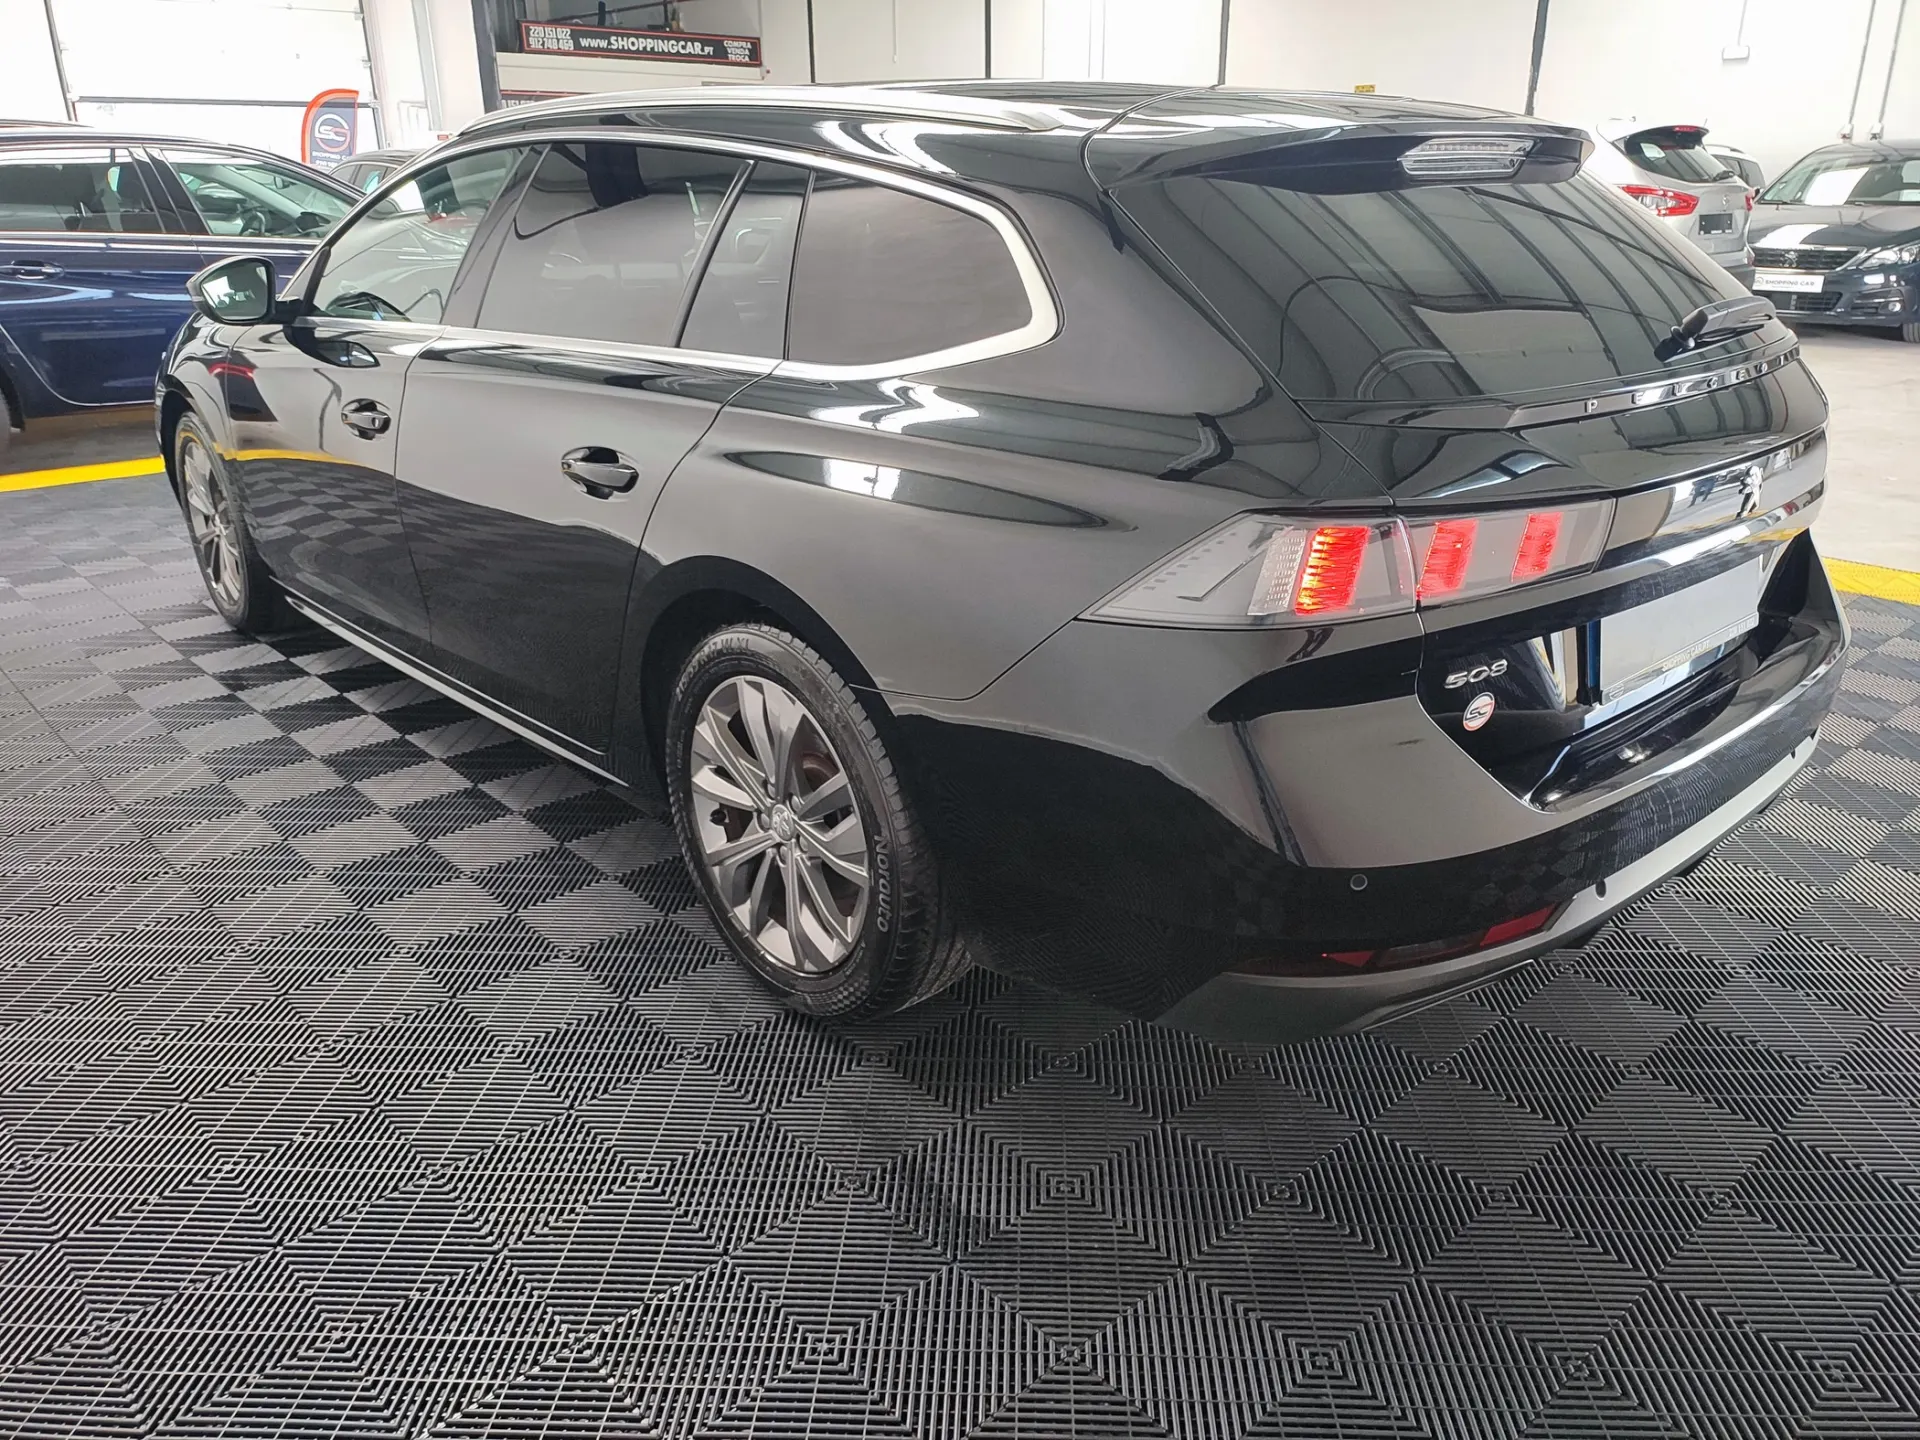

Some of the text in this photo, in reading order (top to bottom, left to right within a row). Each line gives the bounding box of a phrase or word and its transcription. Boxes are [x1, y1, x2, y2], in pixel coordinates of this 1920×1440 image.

[528, 26, 571, 39] 220 151 022
[528, 37, 543, 49] 912
[558, 39, 574, 50] 469
[579, 36, 714, 56] www.SHOPPINGCAR.PT
[723, 40, 752, 49] COMPRA
[727, 47, 750, 55] VENDA
[728, 54, 750, 62] TROCA
[1584, 354, 1785, 413] PEUGEOT
[1444, 659, 1508, 689] 508
[874, 834, 892, 933] Norauto
